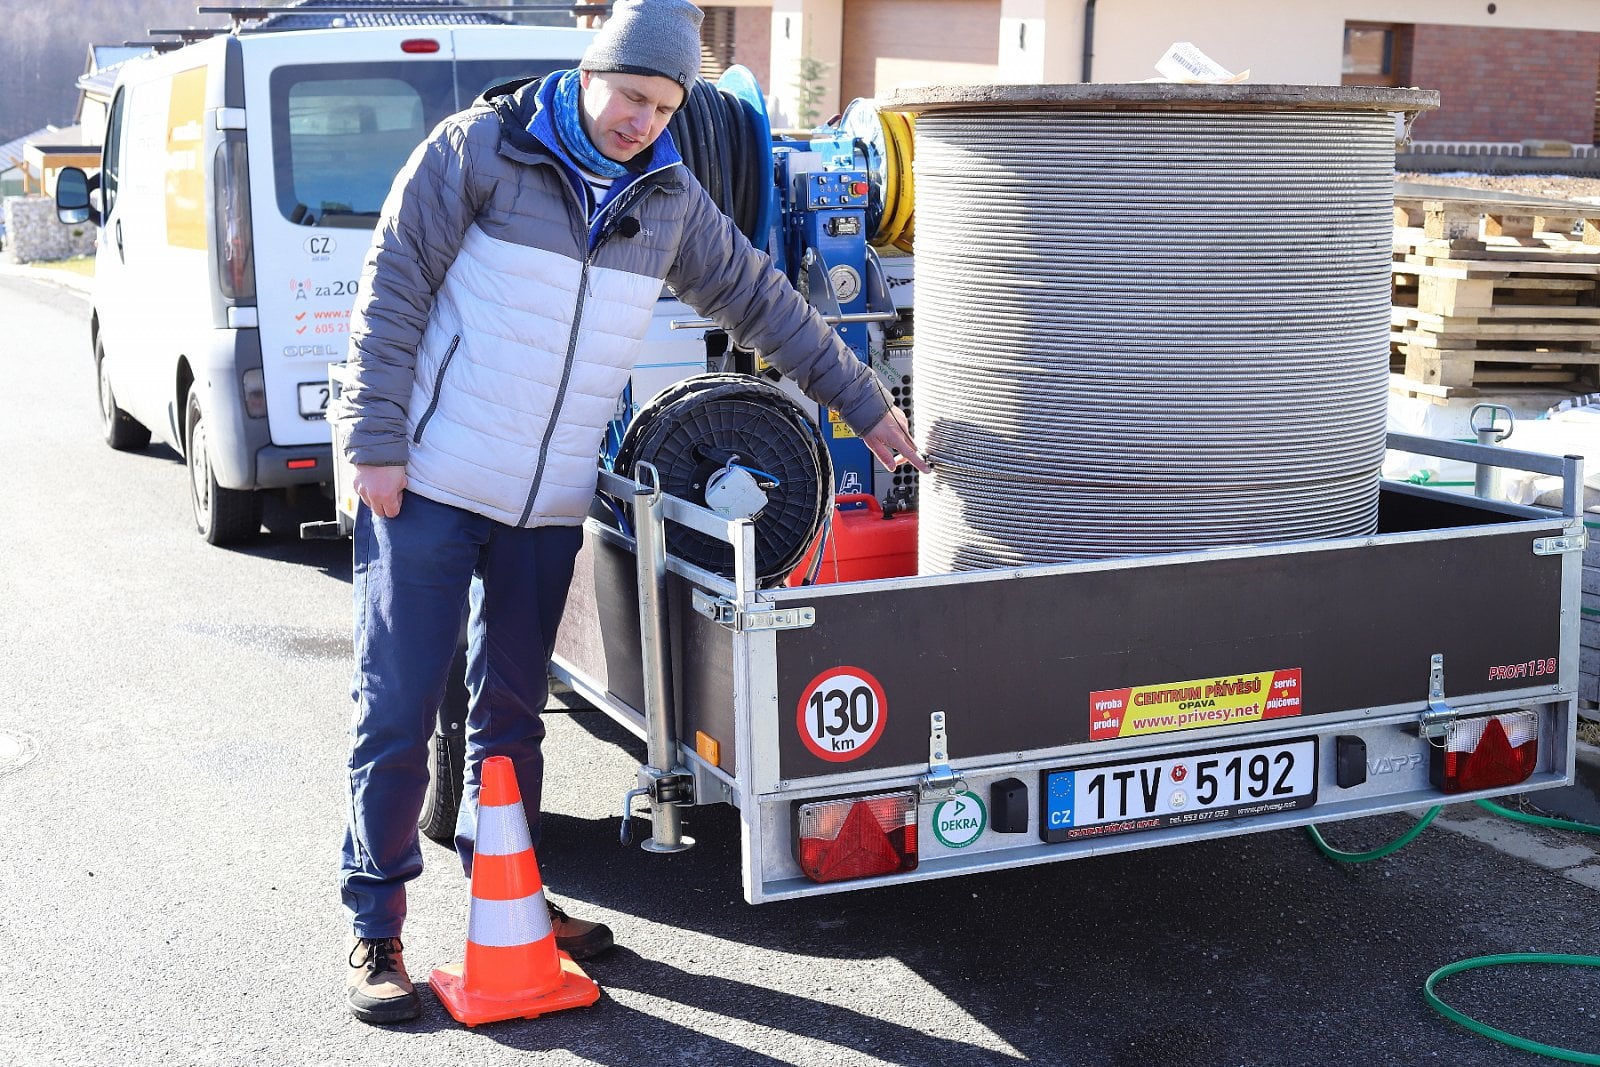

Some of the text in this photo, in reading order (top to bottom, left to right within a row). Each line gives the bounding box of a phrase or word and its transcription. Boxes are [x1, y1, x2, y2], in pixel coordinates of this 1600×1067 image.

[310, 237, 330, 254] CZ
[315, 323, 335, 334] 605
[283, 345, 338, 357] OPEL
[1274, 677, 1297, 688] servis
[1134, 676, 1261, 706] CENTRUM PŘÍVĚSŮ
[1095, 699, 1122, 711] výroba
[1179, 699, 1216, 710] OPAVA
[1266, 697, 1300, 709] půjčovna
[810, 686, 874, 738] 130
[1133, 702, 1260, 729] www.privesy.net
[1094, 717, 1119, 730] prodej
[832, 738, 855, 751] km
[1366, 753, 1423, 776] VAPP
[1088, 751, 1295, 819] 1TV 5192
[1051, 809, 1072, 825] CZ
[941, 817, 978, 831] DEKRA
